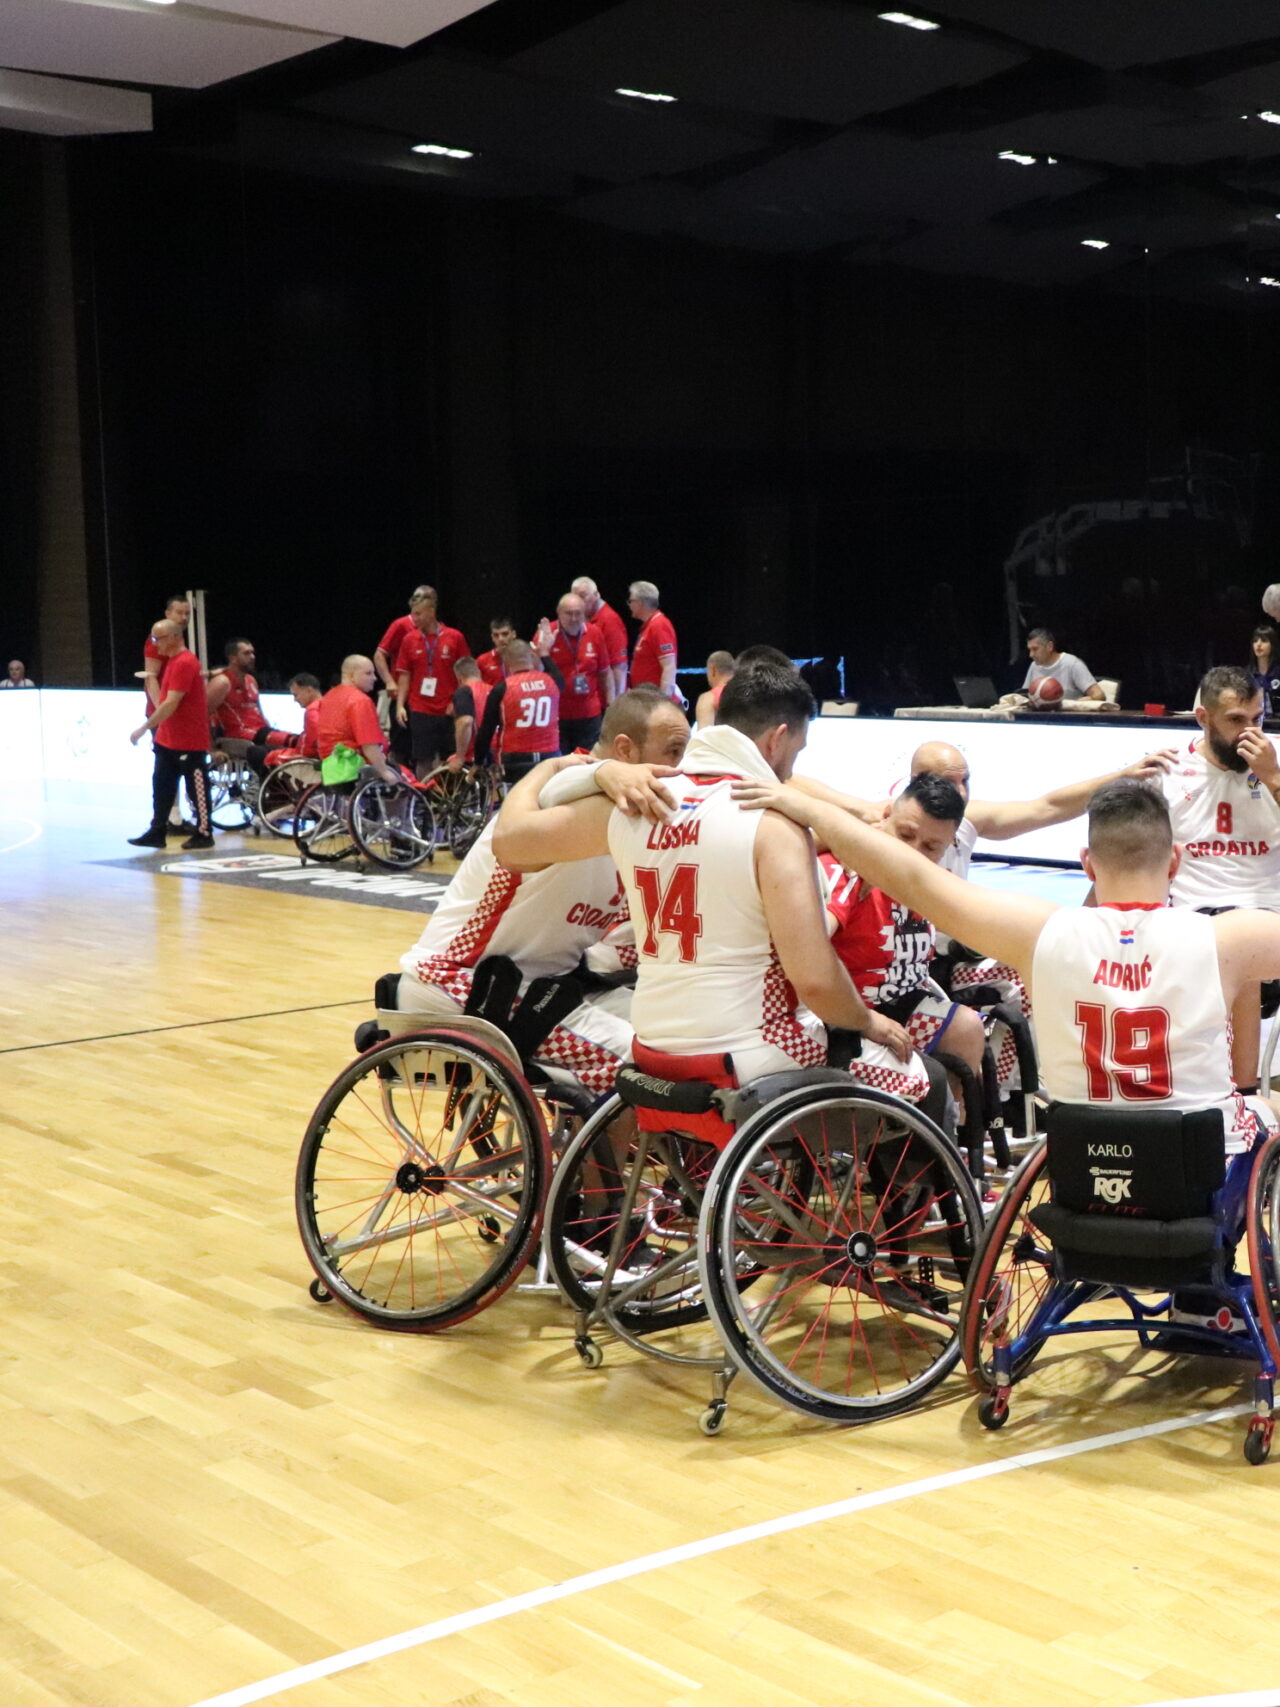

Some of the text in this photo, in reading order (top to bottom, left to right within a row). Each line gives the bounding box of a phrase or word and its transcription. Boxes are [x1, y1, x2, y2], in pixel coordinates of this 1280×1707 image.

[515, 696, 551, 727] 30
[1216, 801, 1233, 834] 8
[1185, 840, 1270, 857] CROATIA
[634, 863, 703, 963] 14
[1093, 954, 1152, 992] ADRIĆ
[1074, 1000, 1173, 1102] 19
[1087, 1144, 1133, 1158] KARLO
